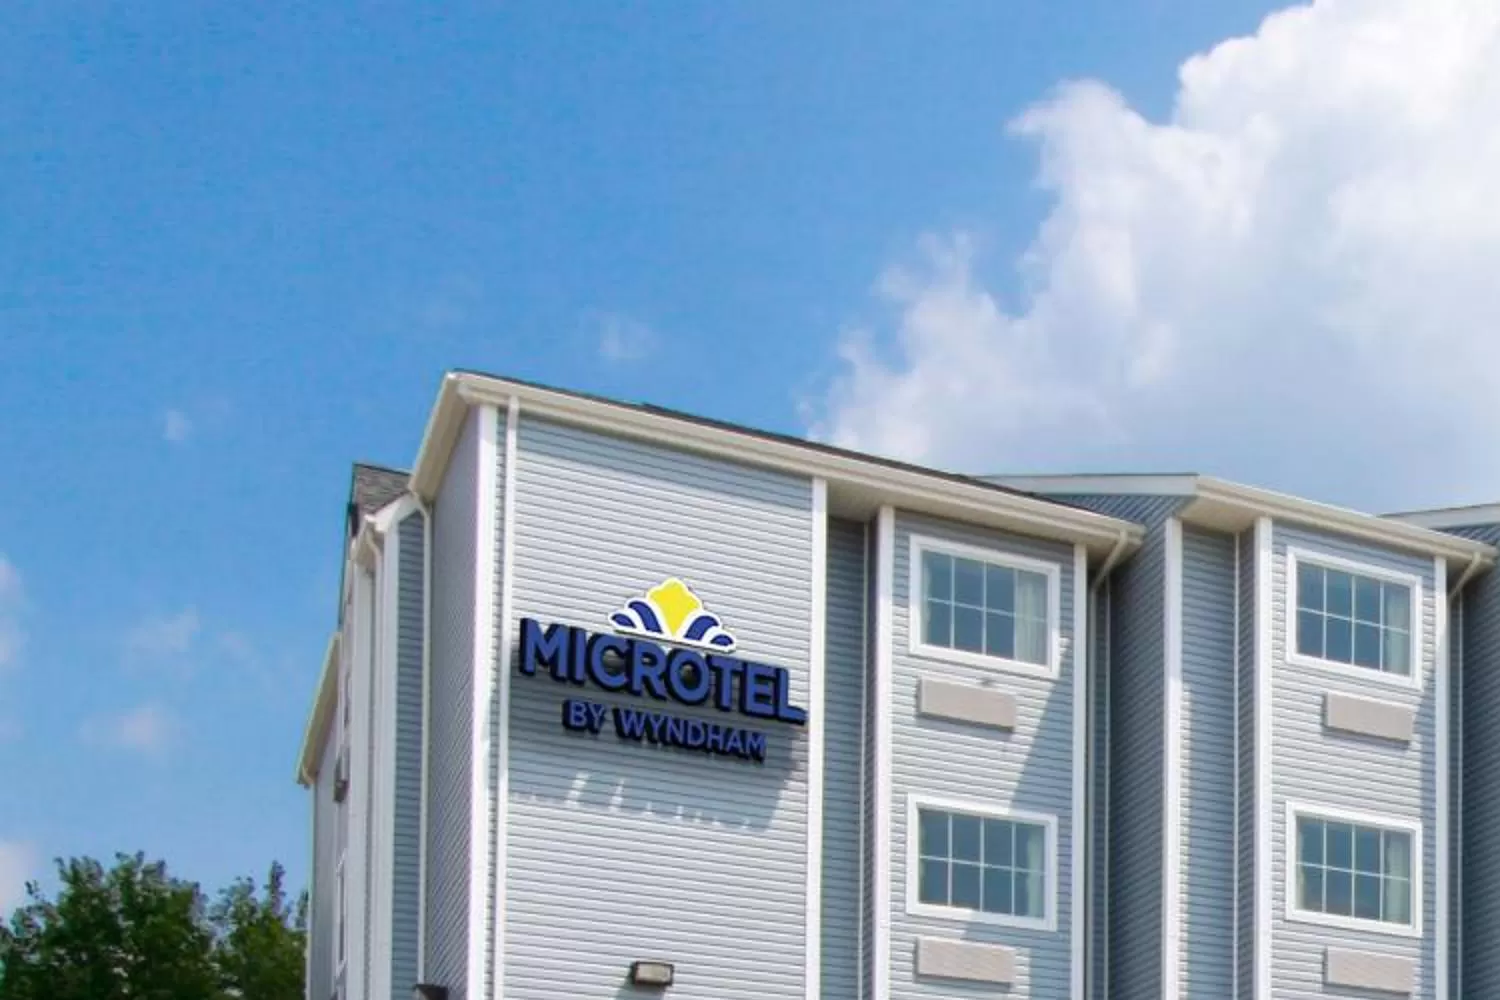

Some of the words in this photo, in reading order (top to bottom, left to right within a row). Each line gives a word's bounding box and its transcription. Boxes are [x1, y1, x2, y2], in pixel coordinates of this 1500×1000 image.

[519, 617, 808, 725] MICROTEL
[564, 700, 605, 733] BY
[615, 706, 768, 762] WYNDHAM
